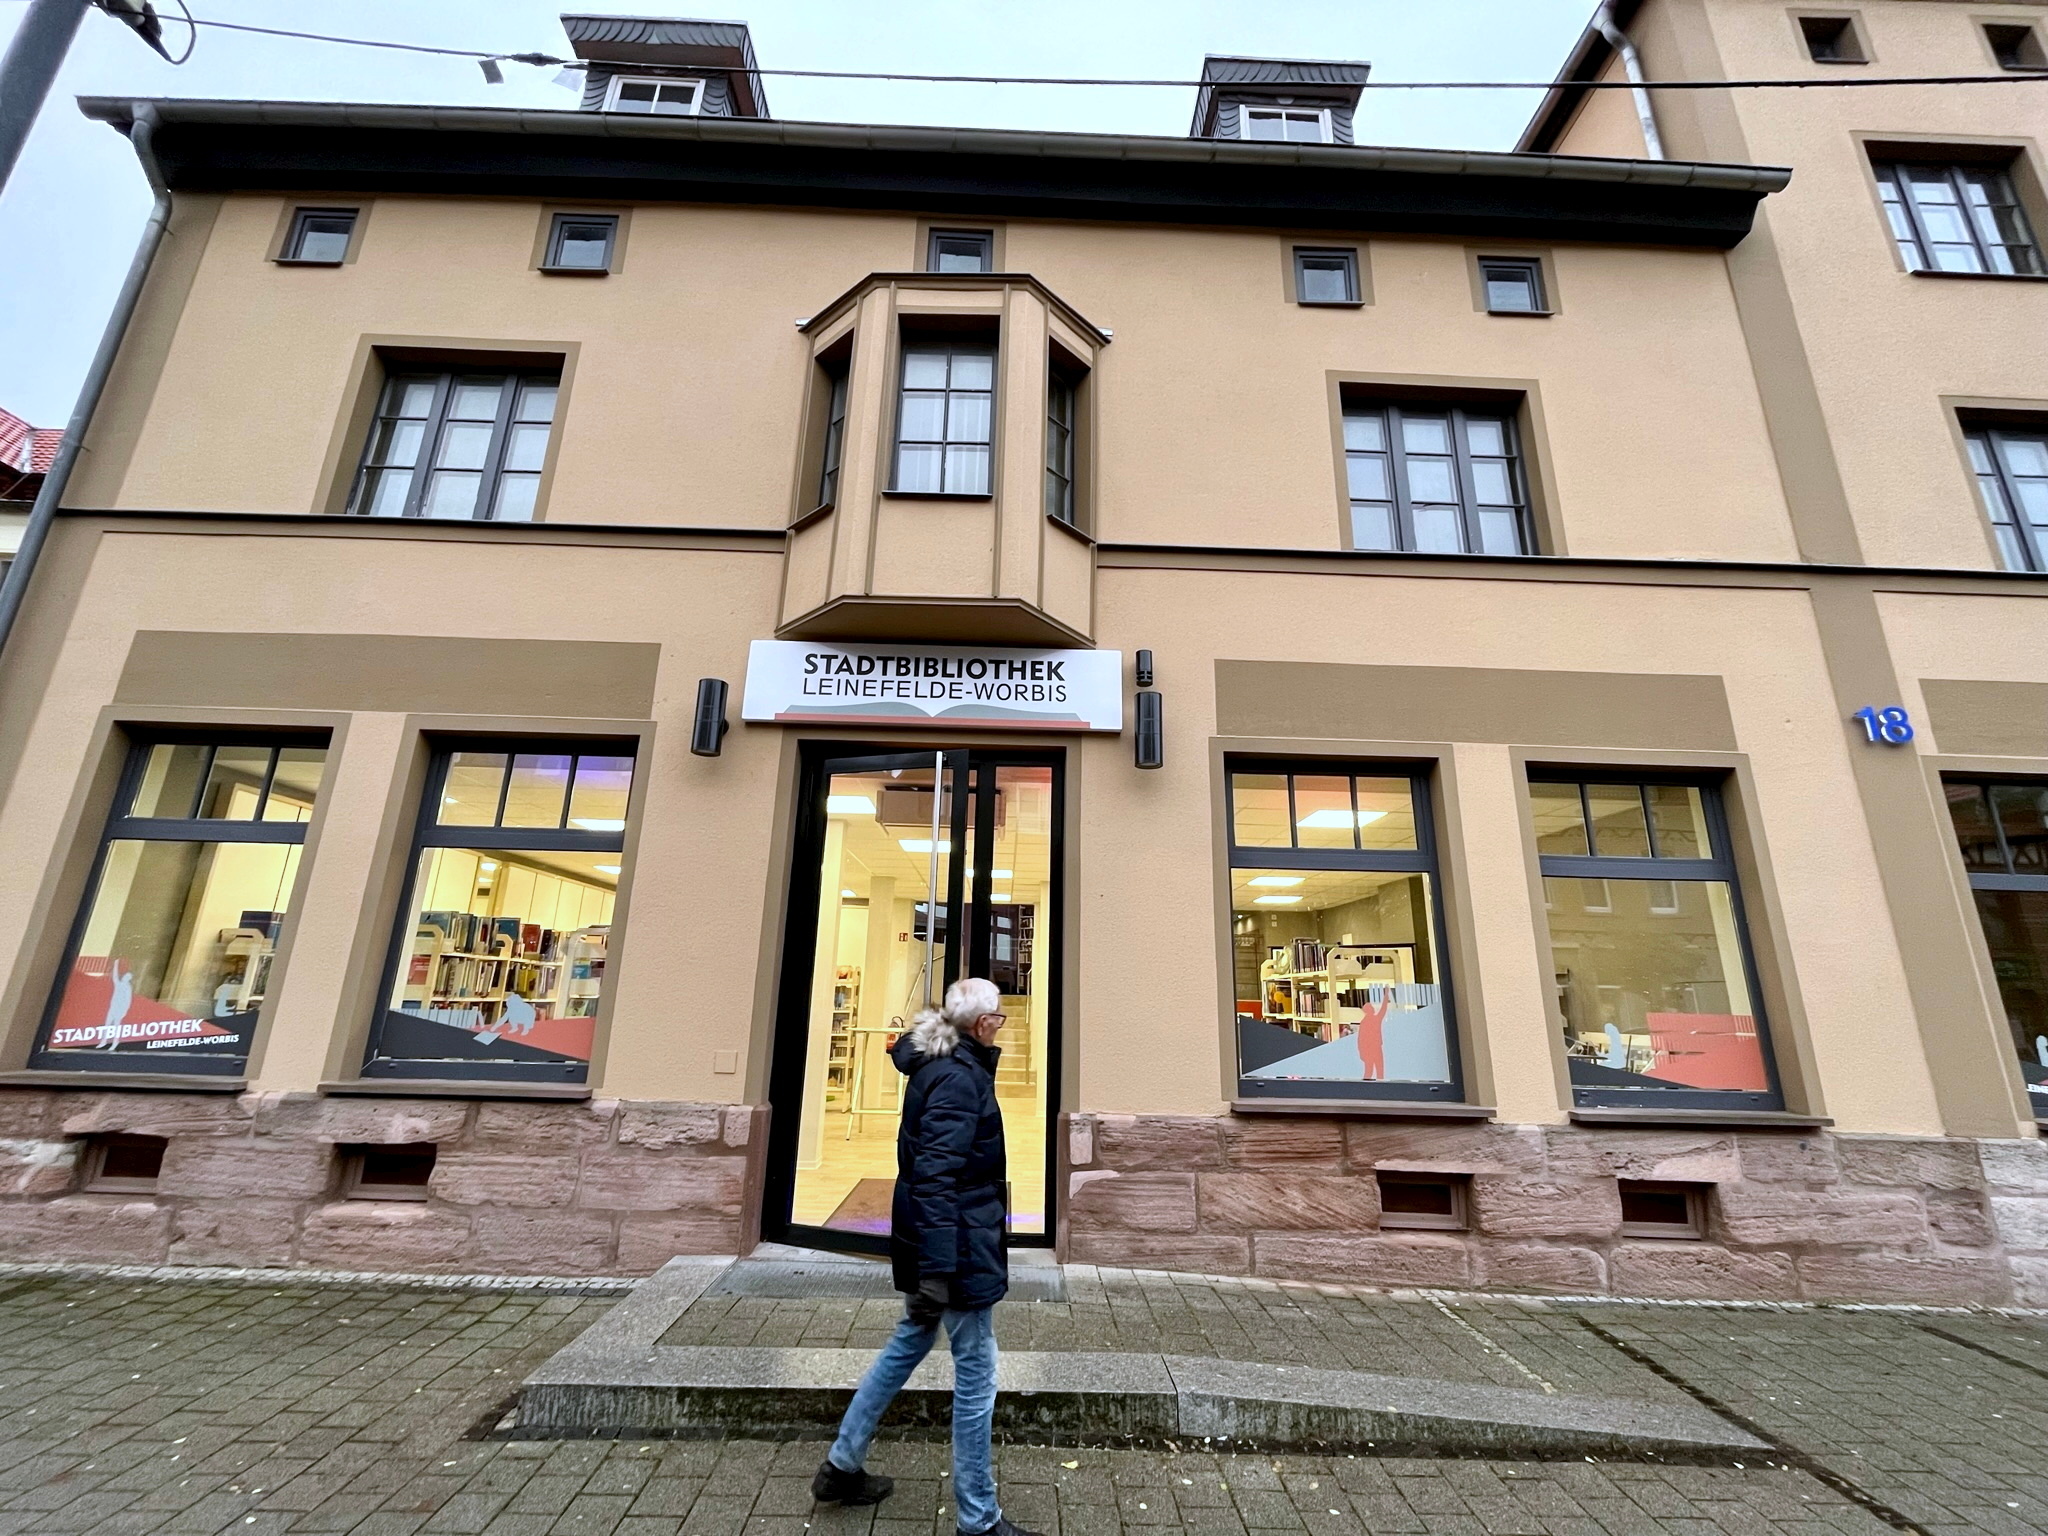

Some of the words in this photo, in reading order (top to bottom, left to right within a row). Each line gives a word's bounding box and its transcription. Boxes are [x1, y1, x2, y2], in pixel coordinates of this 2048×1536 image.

[804, 653, 1065, 681] STADTBIBLIOTHEK
[803, 678, 1067, 702] LEINEFELDE-WORBIS
[1853, 706, 1914, 743] 18
[53, 1018, 204, 1043] STADTBIBLIOTHEK
[146, 1034, 240, 1050] LEINEFELDE-WORBIS
